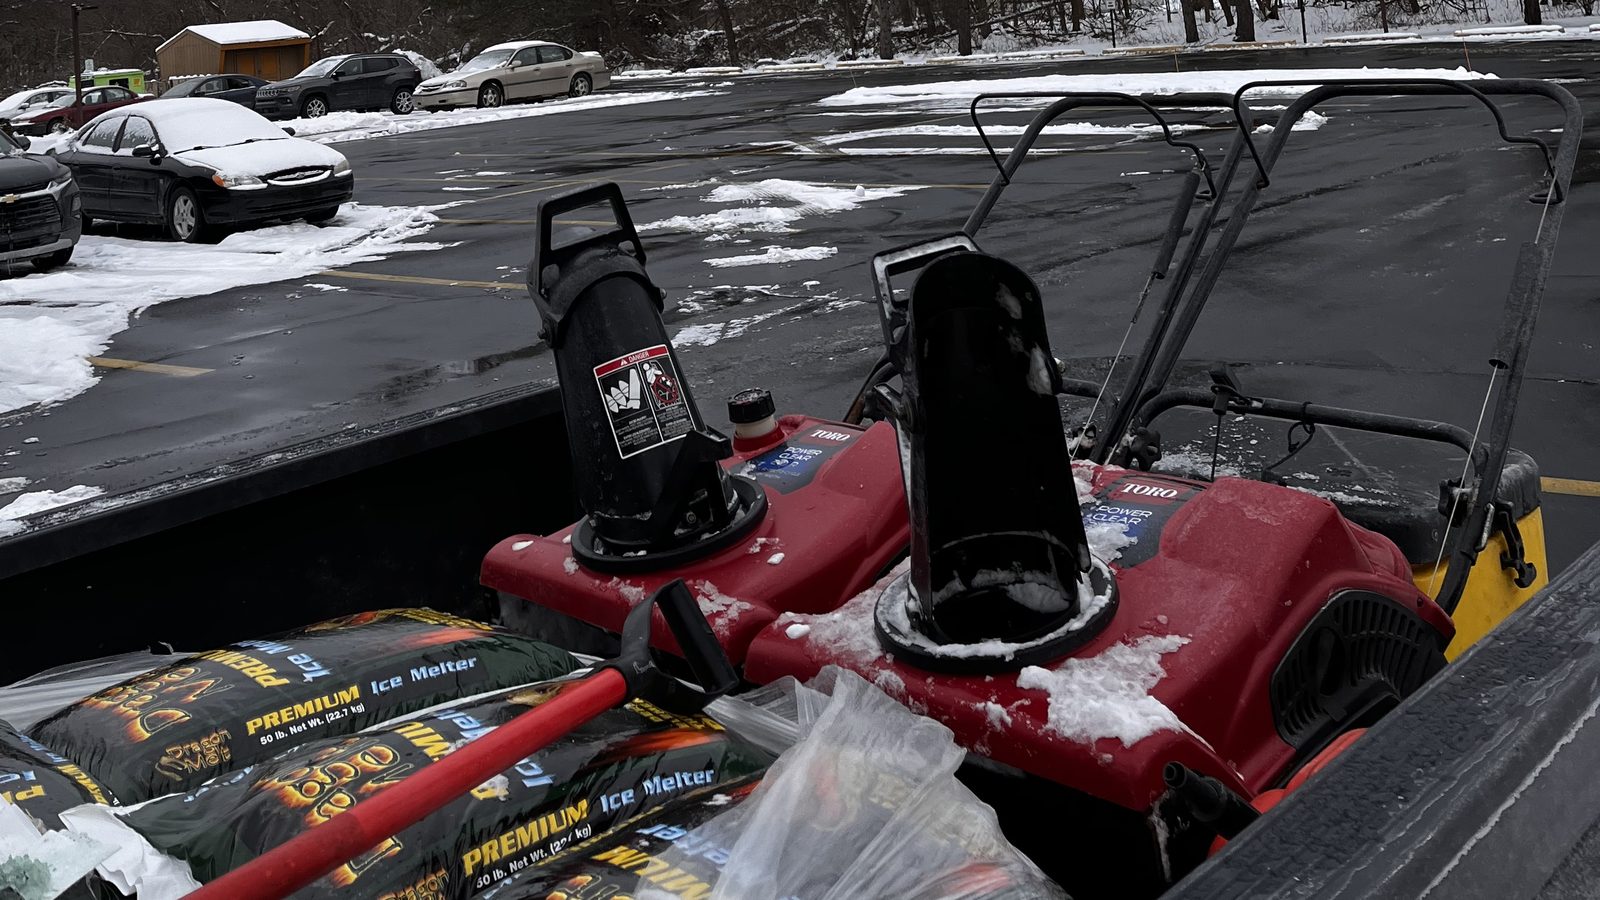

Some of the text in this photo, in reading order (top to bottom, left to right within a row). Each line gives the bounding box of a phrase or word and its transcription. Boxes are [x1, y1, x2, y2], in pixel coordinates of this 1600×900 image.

[628, 351, 650, 363] DANGER
[810, 429, 850, 442] TORO
[779, 452, 812, 462] CLEAR
[785, 446, 822, 456] POWER
[1121, 483, 1178, 498] TORO
[1092, 513, 1142, 525] CLEAR
[1096, 505, 1152, 518] POWER
[371, 657, 477, 696] Ice Melter
[246, 685, 360, 736] PREMIUM
[260, 703, 366, 745] 50 lb. Net Wt. (22.7 kg)
[166, 729, 232, 759] Dragon
[183, 745, 231, 773] Melt
[600, 769, 715, 815] Ice Melter
[462, 799, 588, 878] PREMIUM
[476, 874, 490, 889] 50
[492, 868, 507, 881] lb.
[509, 856, 529, 873] Net
[530, 849, 548, 862] Wt.
[575, 823, 592, 838] kg)
